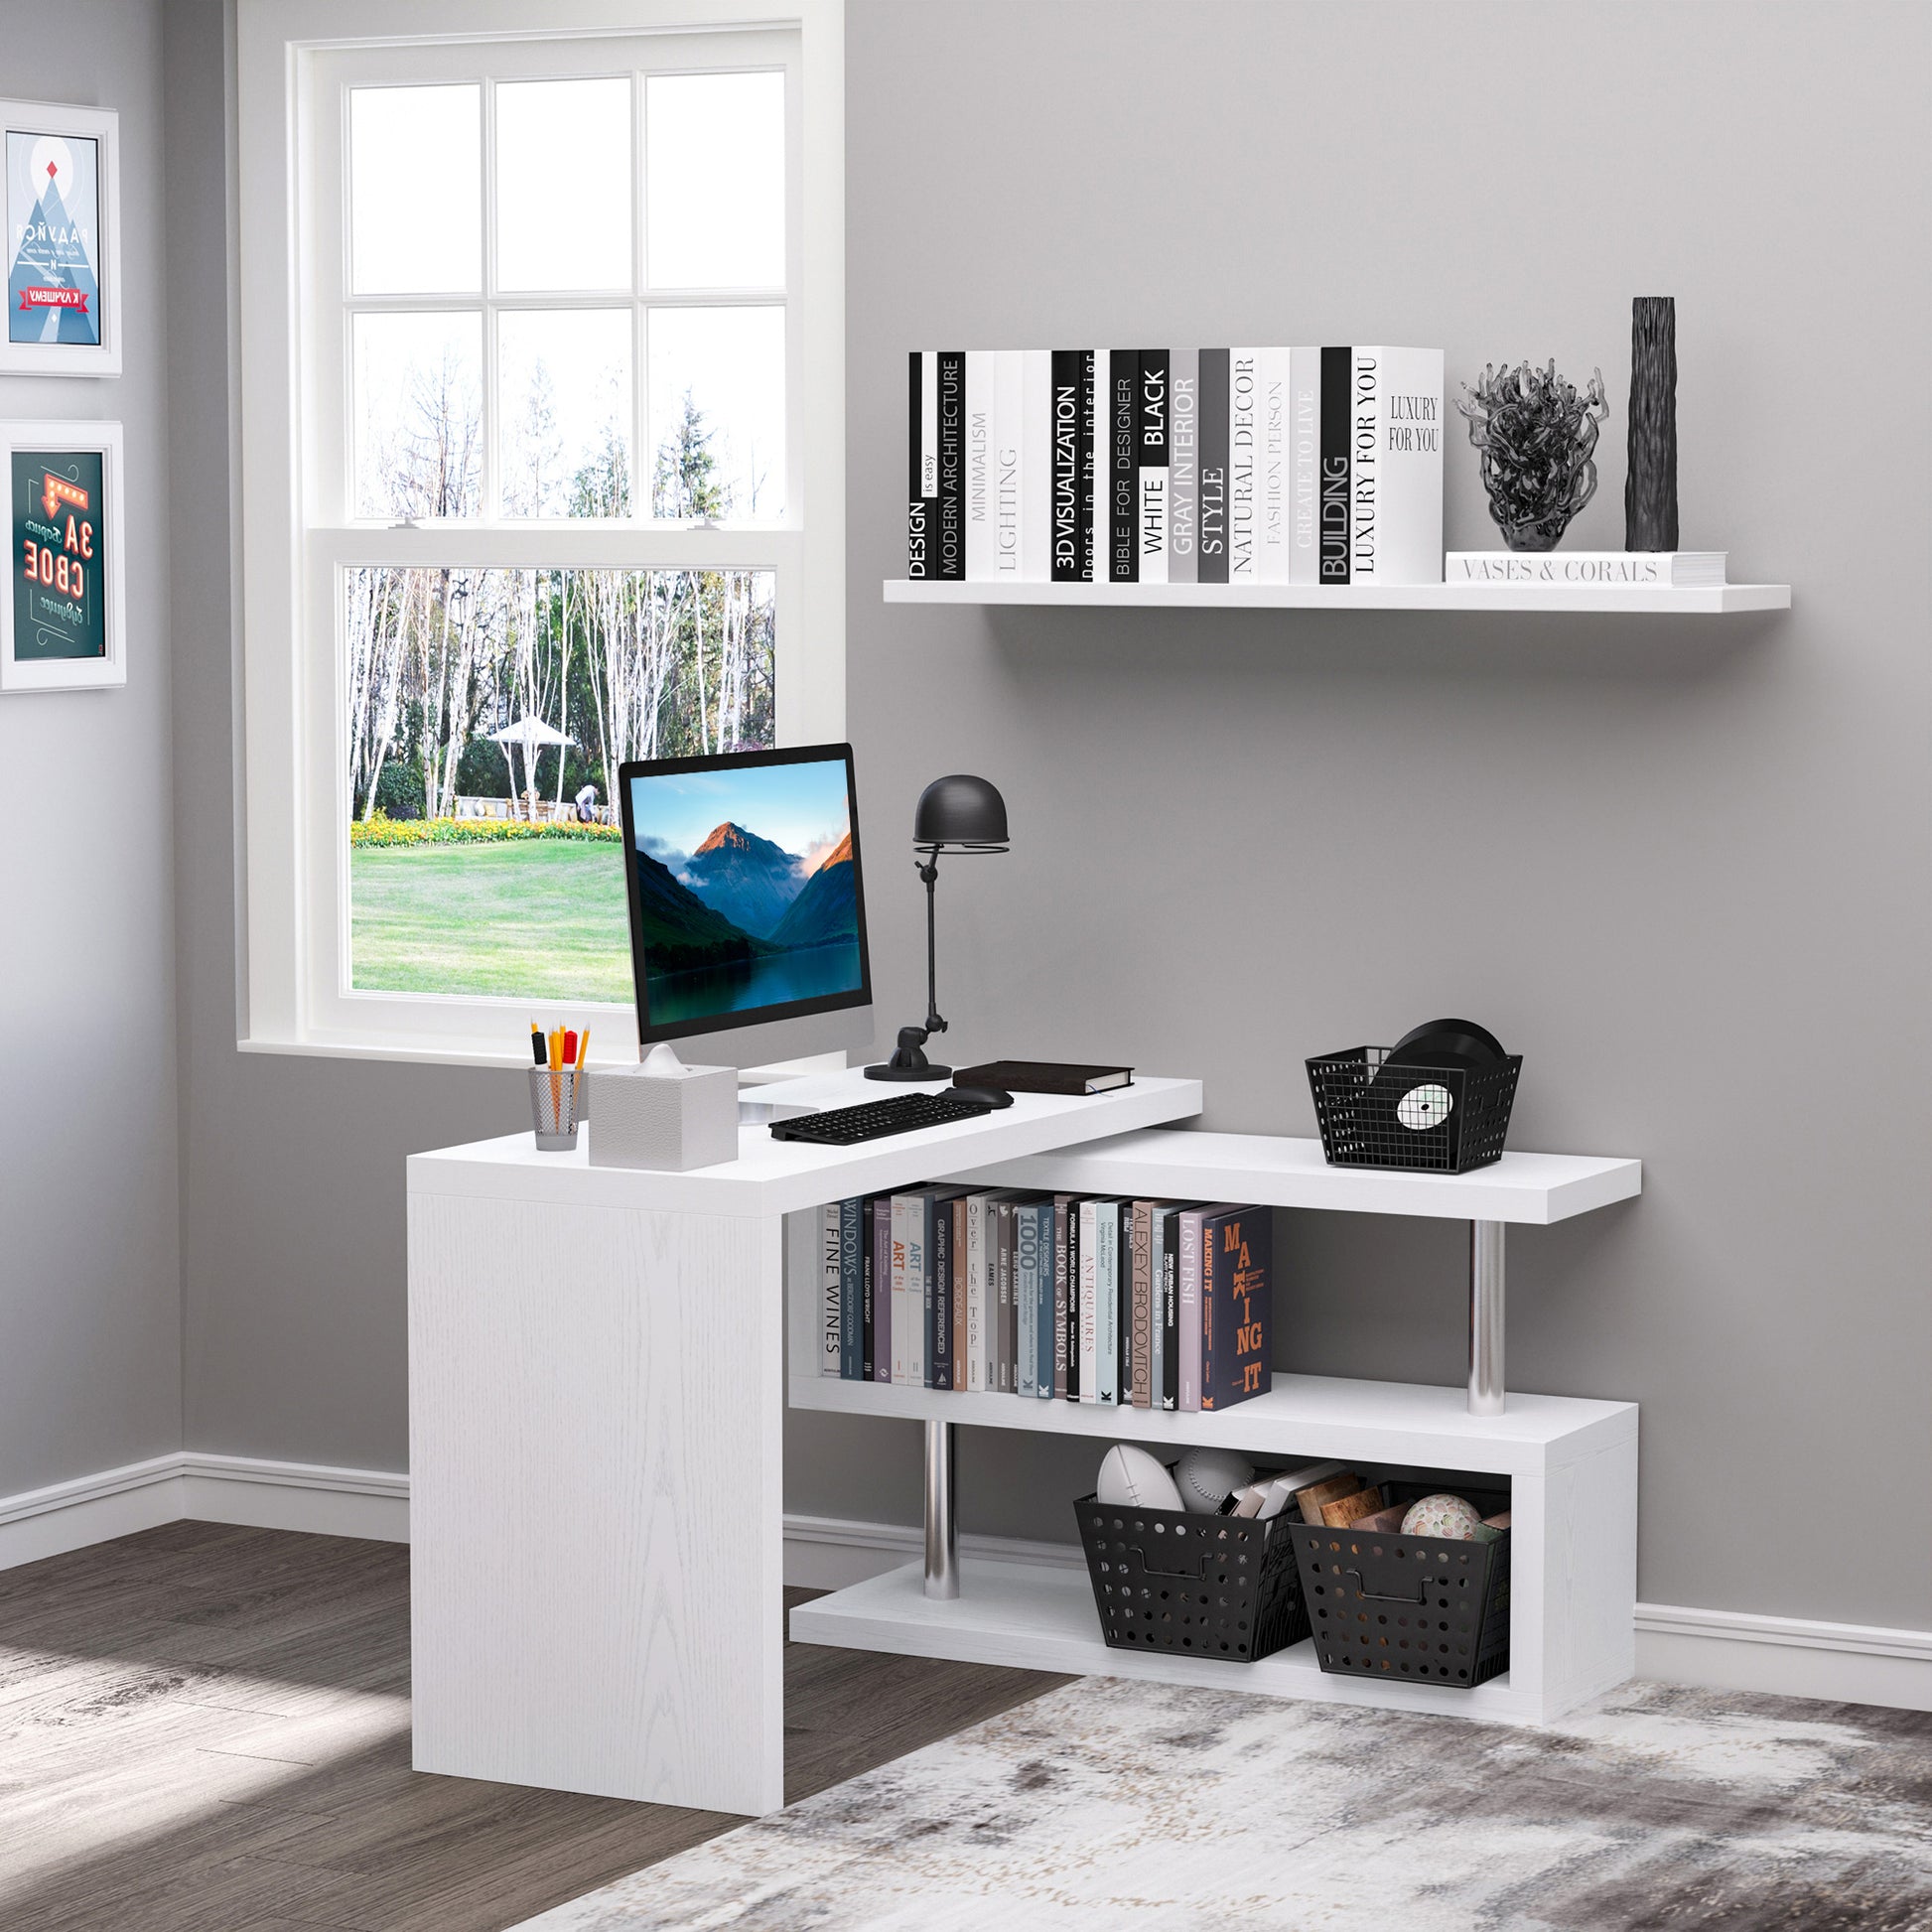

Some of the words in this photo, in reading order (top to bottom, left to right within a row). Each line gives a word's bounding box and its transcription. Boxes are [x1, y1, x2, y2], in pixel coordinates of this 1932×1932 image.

[1083, 354, 1094, 436] interior
[1145, 369, 1165, 446] BLACK
[1234, 357, 1254, 447] DECOR
[1356, 356, 1377, 406] YOU
[1391, 396, 1439, 421] LUXURY
[943, 360, 958, 491] ARCHITECTURE
[1117, 379, 1131, 470] DESIGNER
[1174, 378, 1194, 485] INTERIOR
[1268, 381, 1283, 454] PERSON
[1298, 390, 1313, 435] LIVE
[1356, 416, 1376, 464] FOR
[1389, 428, 1414, 451] FOR
[1416, 428, 1439, 452] YOU
[924, 455, 936, 481] easy
[972, 413, 986, 521] MINIMALISM
[1056, 386, 1075, 538] VISUALIZATION
[1083, 452, 1094, 480] the
[1297, 440, 1312, 468] TO
[923, 483, 932, 492] is
[1000, 449, 1017, 570] LIGHTING
[1117, 480, 1131, 516] FOR
[1202, 468, 1224, 555] STYLE
[1234, 456, 1253, 573] NATURAL
[1267, 462, 1282, 544] FASHION
[1297, 472, 1312, 548] CREATE
[1323, 457, 1348, 576] BUILDING
[909, 502, 925, 577] DESIGN
[943, 496, 957, 574] MODERN
[1144, 481, 1163, 554] WHITE
[1173, 492, 1193, 555] GRAY
[1355, 474, 1376, 573] LUXURY
[1117, 527, 1131, 575] BIBLE
[1463, 559, 1533, 581] VASES
[1539, 560, 1557, 581] &
[1565, 560, 1658, 582] CORALS
[826, 1228, 840, 1275] FINE
[843, 1199, 858, 1276] WINDOWS
[894, 1241, 904, 1271] ART
[909, 1242, 921, 1272] ART
[1020, 1215, 1036, 1270] 1000
[1055, 1245, 1066, 1285] BOOK
[1134, 1207, 1148, 1277] ALEXEY
[1182, 1220, 1195, 1263] LOST
[1204, 1228, 1213, 1277] MAKING
[954, 1277, 963, 1325] BORDEAUX
[1084, 1255, 1094, 1352] ANTIQUAIRES
[1154, 1269, 1164, 1309] Gardens
[1155, 1311, 1164, 1319] in
[1182, 1268, 1195, 1304] FISH
[1204, 1279, 1213, 1293] IT
[826, 1285, 840, 1353] WINES
[1055, 1301, 1066, 1372] SYMBOLS
[1134, 1281, 1148, 1394] BRODOVITCH
[1154, 1322, 1164, 1355] France
[1244, 1361, 1262, 1393] IT
